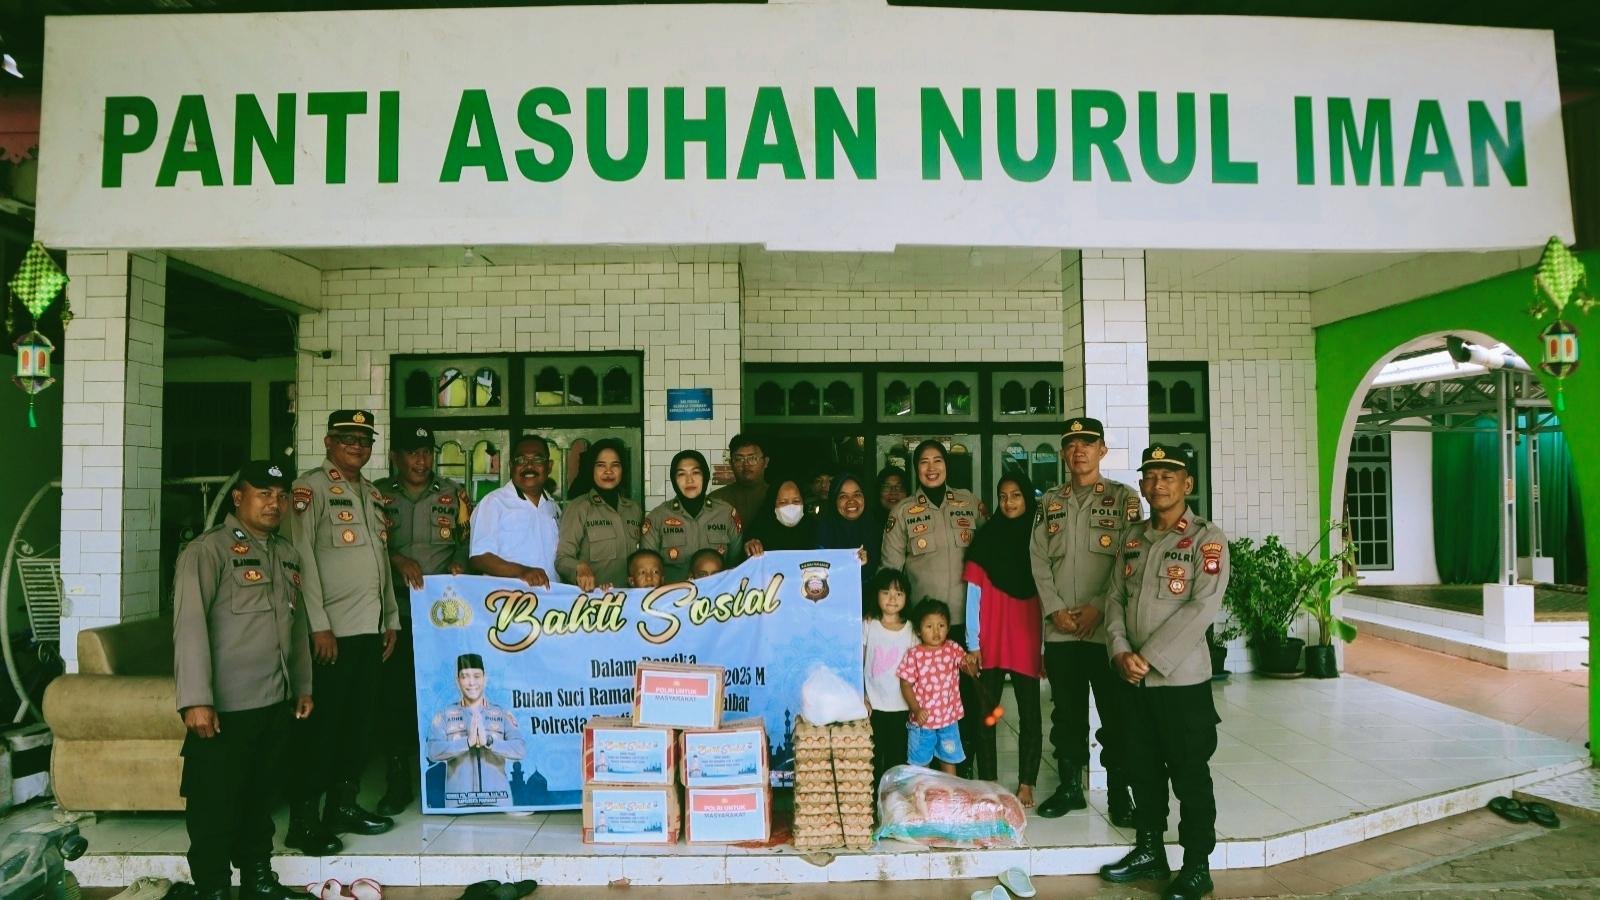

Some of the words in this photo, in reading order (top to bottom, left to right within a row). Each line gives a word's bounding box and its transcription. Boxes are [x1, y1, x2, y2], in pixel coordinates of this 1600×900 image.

[102, 90, 400, 188] PANTI
[439, 86, 877, 183] ASUHAN
[921, 87, 1259, 184] NURUL
[1295, 96, 1527, 187] IMAN
[1164, 551, 1194, 562] POLRI
[485, 589, 626, 653] Bakti
[637, 573, 784, 644] Sosial
[512, 689, 553, 709] Bulan
[557, 687, 585, 707] Suci
[755, 666, 766, 686] M
[591, 658, 637, 679] Dalam
